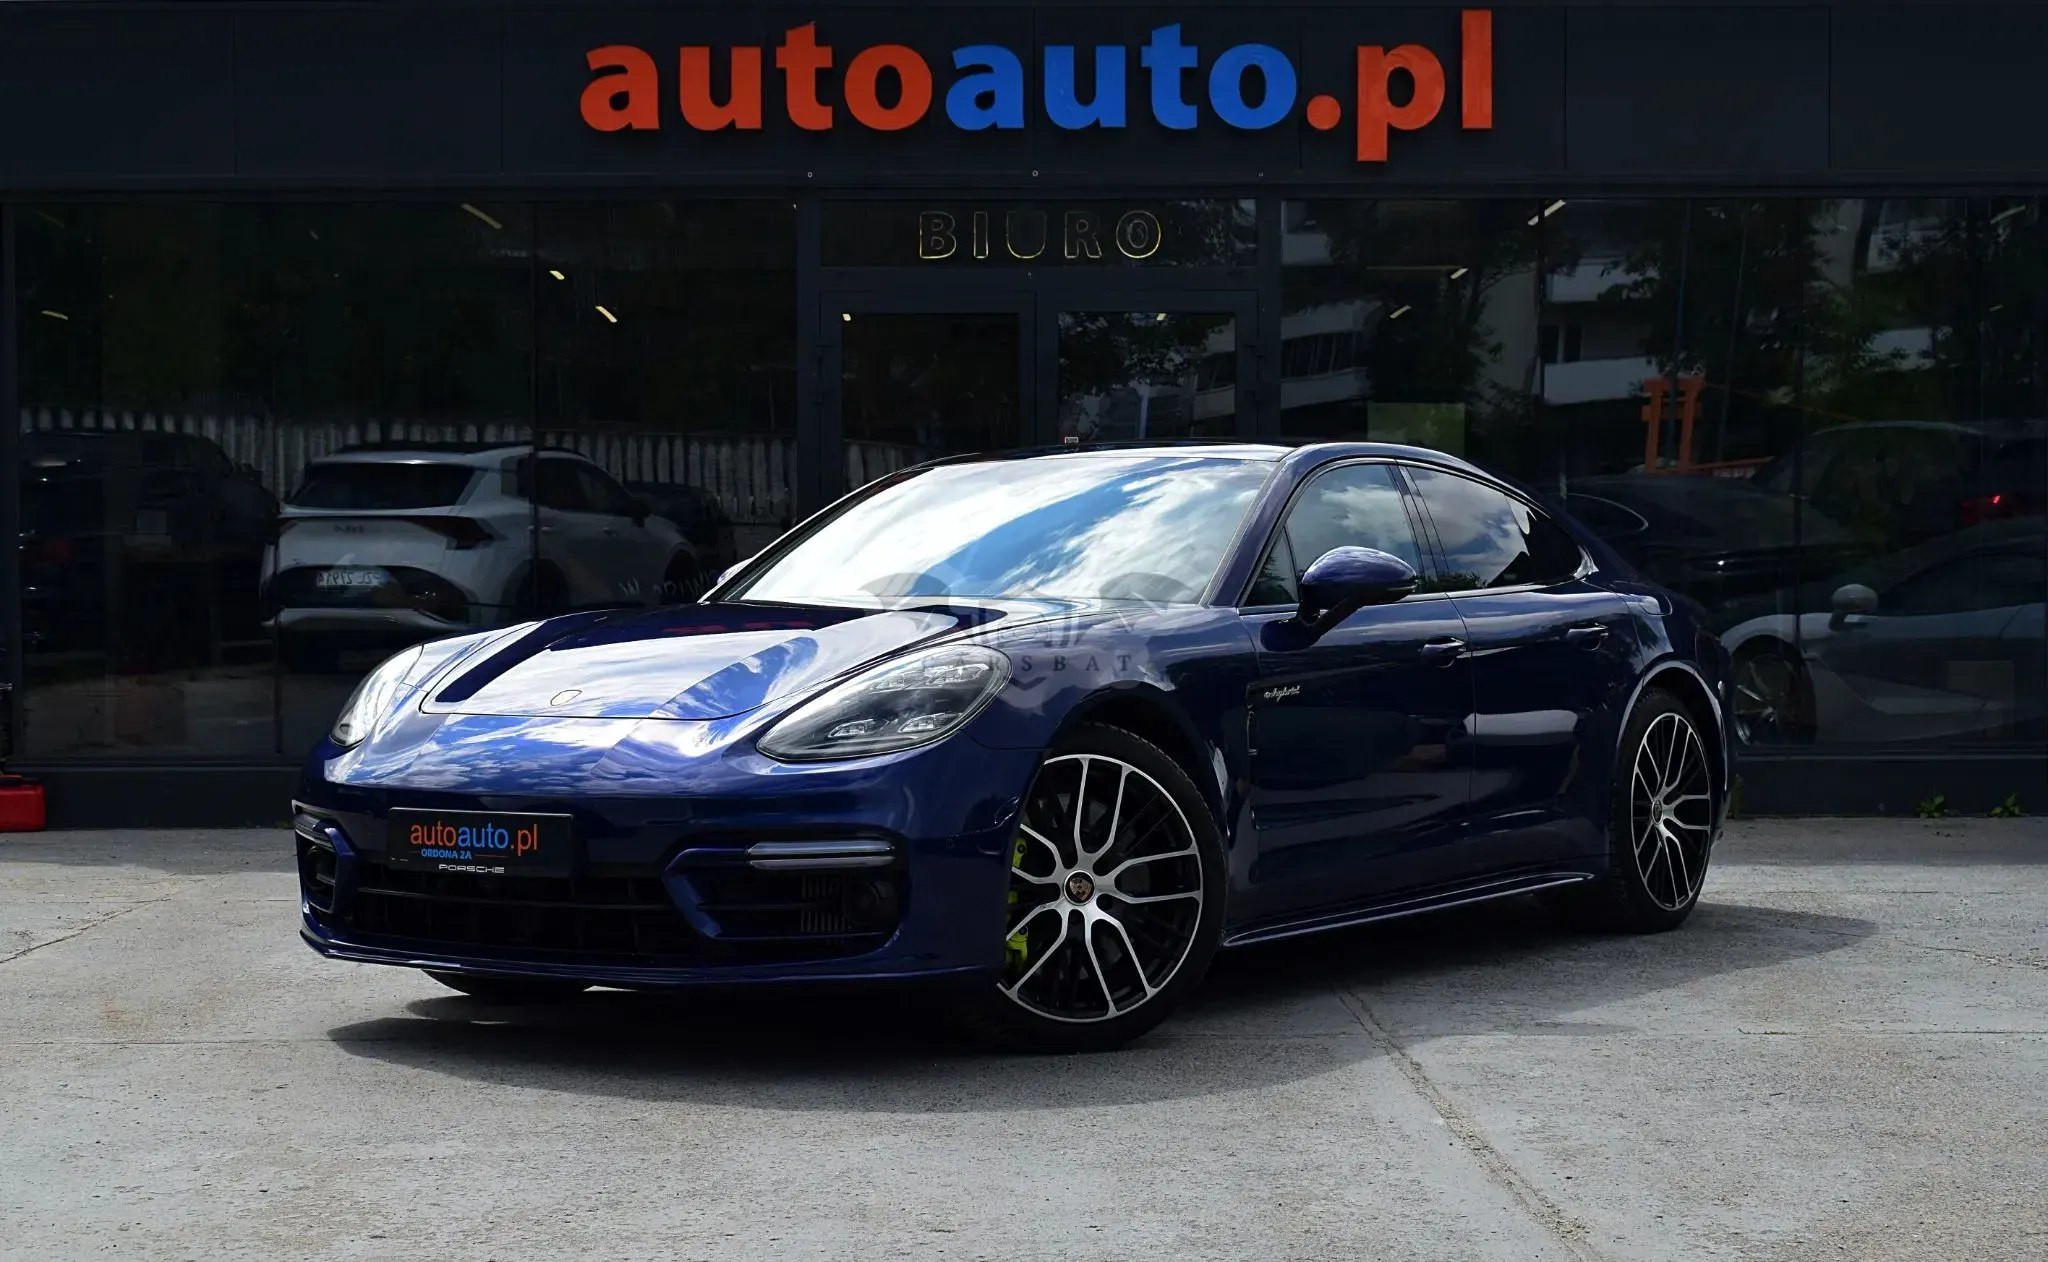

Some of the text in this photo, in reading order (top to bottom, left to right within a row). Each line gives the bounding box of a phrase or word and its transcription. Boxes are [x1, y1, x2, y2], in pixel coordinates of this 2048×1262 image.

[579, 9, 1493, 162] autoauto.pl
[919, 209, 1162, 259] BIURO
[410, 820, 538, 857] autoauto.pl
[439, 863, 505, 874] PORSCHE
